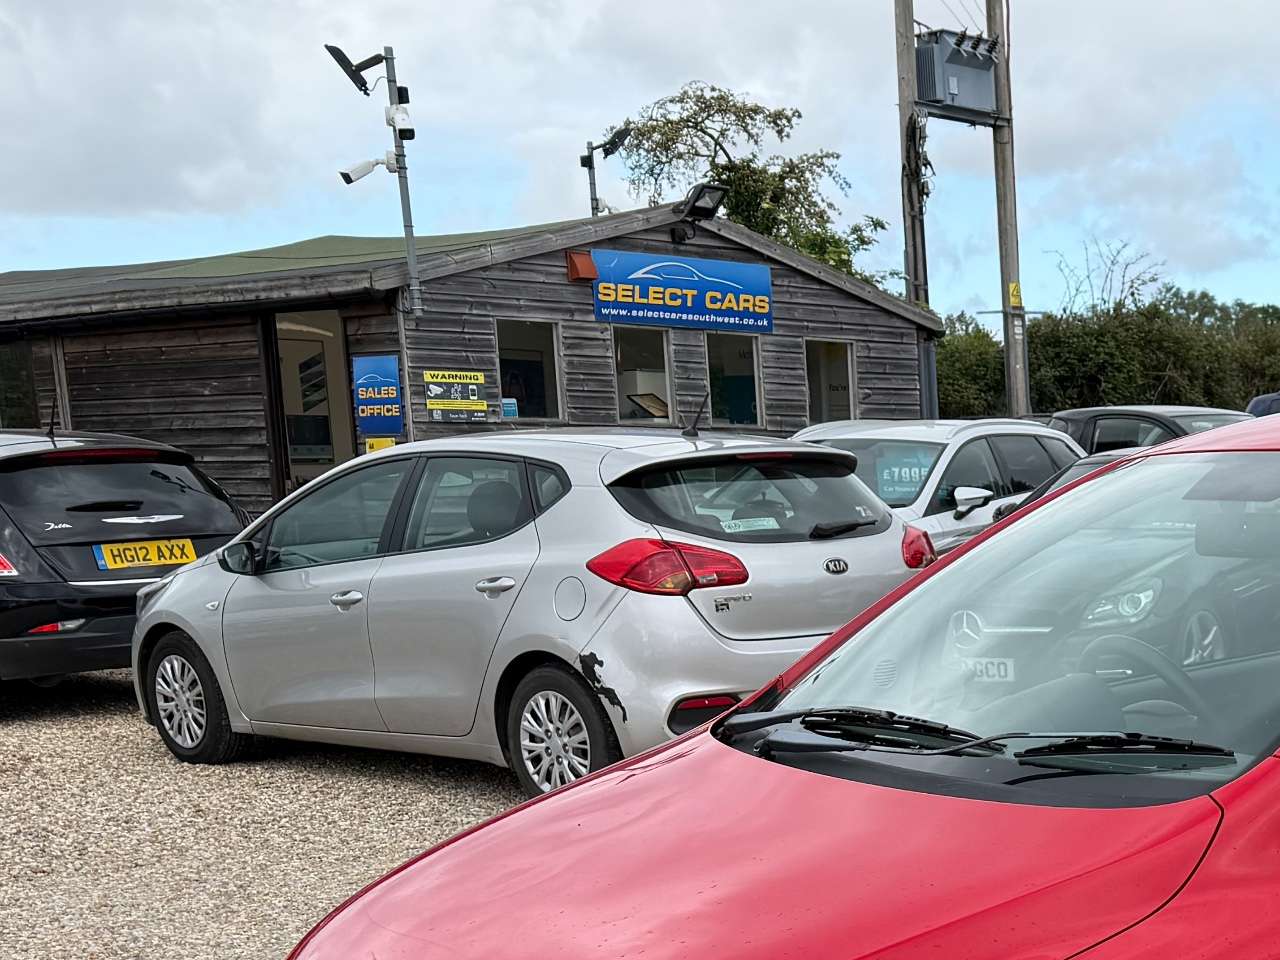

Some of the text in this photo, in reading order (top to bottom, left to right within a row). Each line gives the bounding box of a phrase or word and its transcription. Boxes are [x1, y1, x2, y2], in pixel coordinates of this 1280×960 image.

[598, 282, 770, 314] SELECT CARS
[601, 306, 769, 327] www.selectcarssouthwest.co.uk
[429, 372, 480, 381] WARNING
[358, 386, 397, 399] SALES
[358, 404, 400, 416] OFFICE
[109, 543, 191, 565] HG12 AXX
[828, 560, 847, 572] KIA
